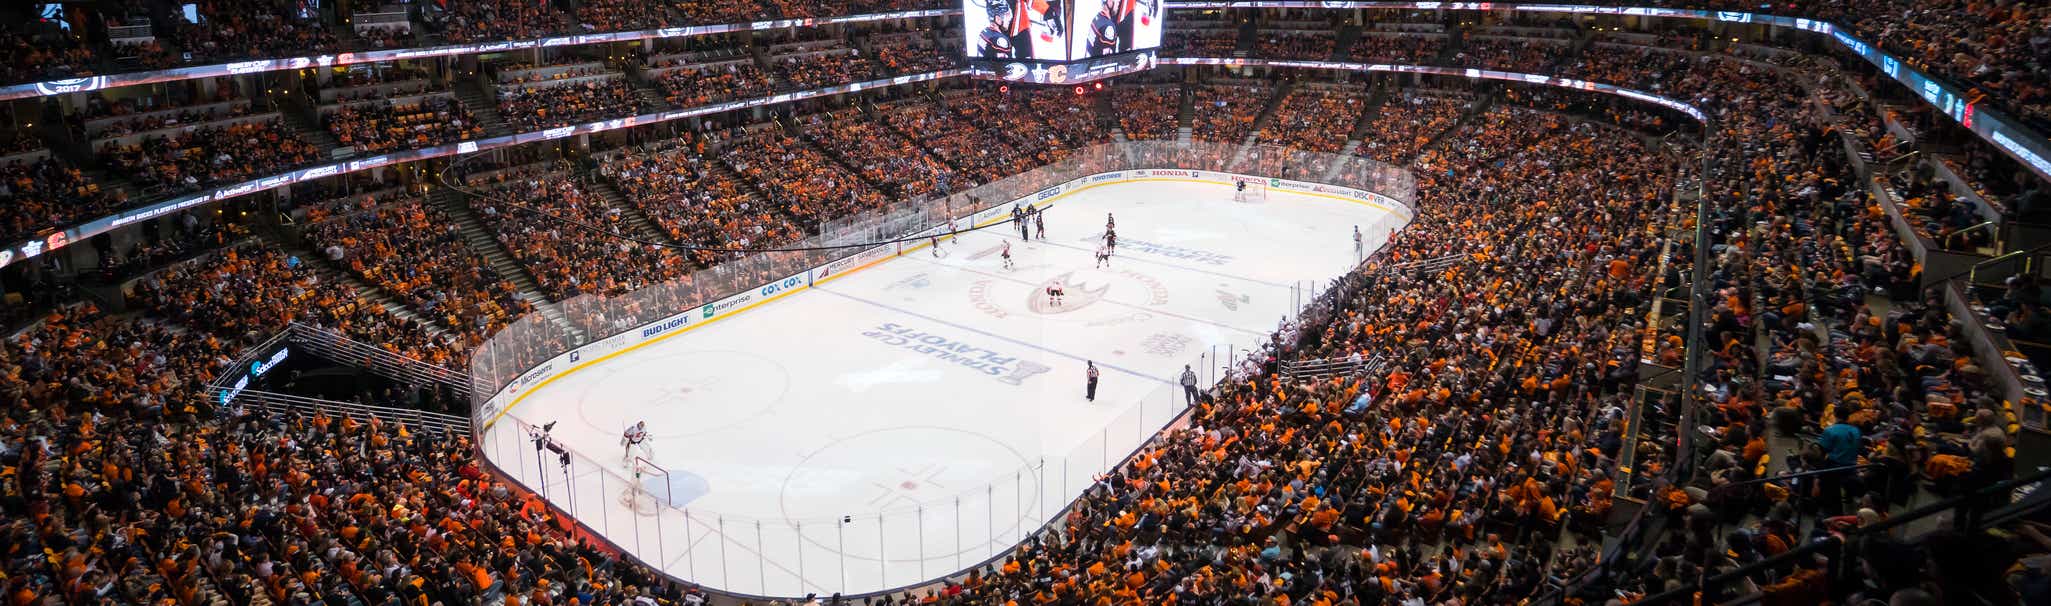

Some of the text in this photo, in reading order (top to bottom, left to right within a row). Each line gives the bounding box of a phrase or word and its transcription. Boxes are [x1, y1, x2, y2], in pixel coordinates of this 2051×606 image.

[55, 85, 81, 93] 2017
[1037, 187, 1060, 200] GEICO
[1354, 190, 1384, 204] DISCOVER
[761, 284, 781, 296] COX
[783, 277, 802, 289] COX
[643, 316, 688, 338] BUD LIGHT
[876, 321, 1018, 365] PLAYOFFS
[861, 330, 1010, 376] STANLEY CUP
[255, 361, 274, 377] Select
